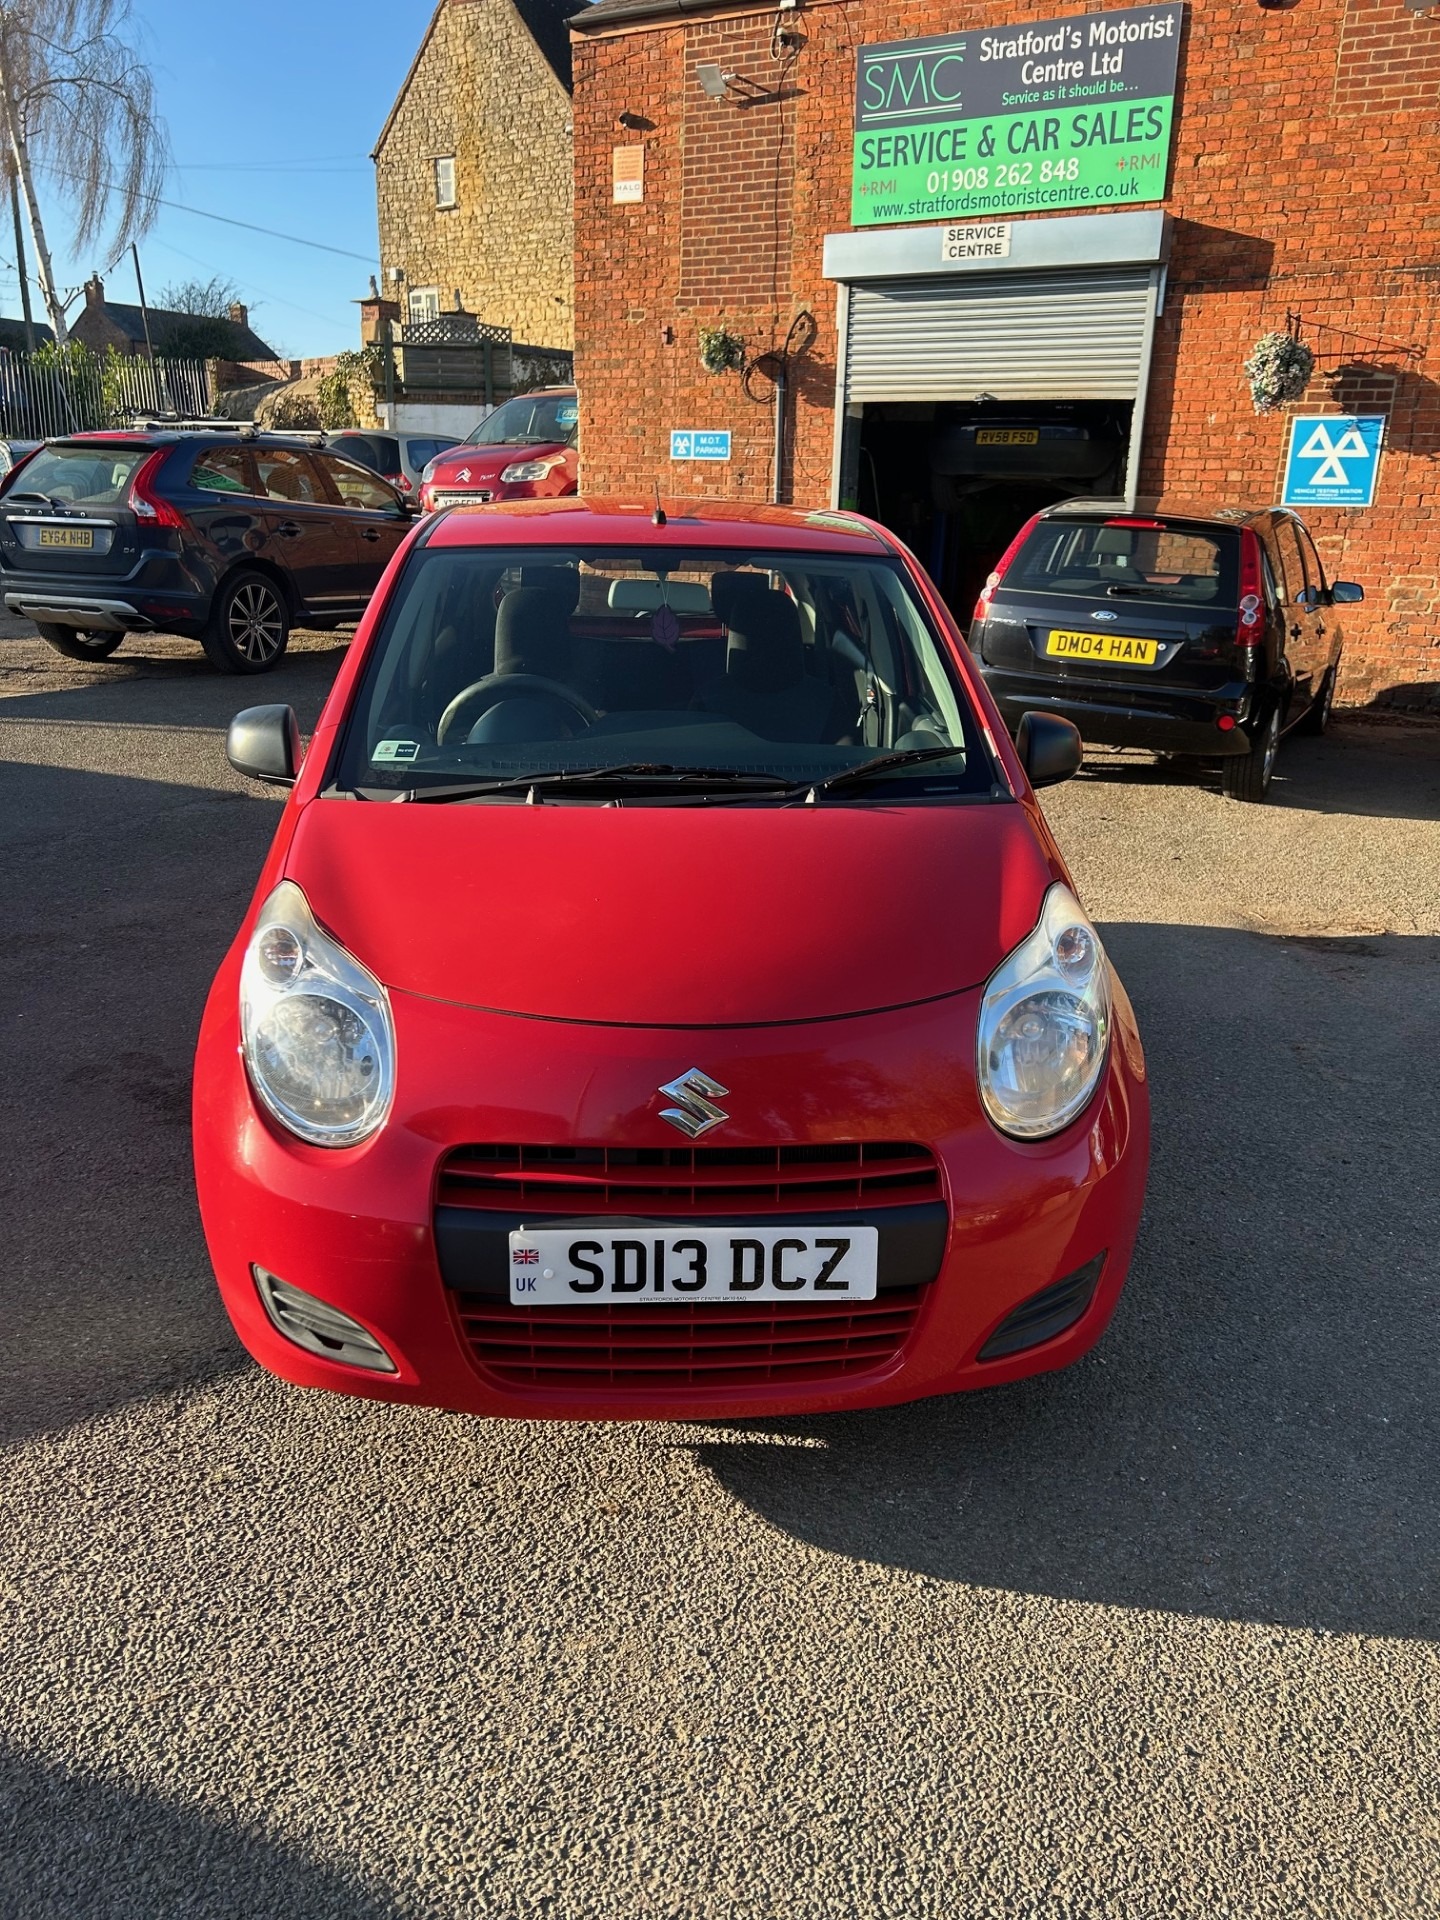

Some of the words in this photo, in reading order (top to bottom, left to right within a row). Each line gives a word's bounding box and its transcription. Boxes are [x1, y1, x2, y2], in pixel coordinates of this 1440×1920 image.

[980, 25, 1082, 61] Stratford's
[1088, 14, 1175, 47] Motorist
[1021, 58, 1084, 85] Centre
[1090, 48, 1124, 77] Ltd
[863, 55, 964, 110] SMC
[1001, 90, 1039, 106] Service
[1042, 89, 1055, 101] as
[1058, 85, 1066, 99] it
[1068, 79, 1107, 98] should
[860, 127, 968, 170] SERVICE
[977, 125, 996, 158] &
[1007, 117, 1061, 154] CAR
[1070, 105, 1163, 148] SALES
[1129, 152, 1161, 171] RMI
[927, 166, 989, 194] 01908
[994, 162, 1033, 188] 262
[1039, 157, 1080, 183] 848
[870, 179, 897, 196] RMI
[873, 177, 1139, 218] www.stratfordsmotoristcentre.co.uk
[948, 225, 1006, 241] SERVICE
[948, 243, 1003, 258] CENTRE
[980, 431, 1009, 443] RV58
[1011, 431, 1034, 443] FSD
[695, 446, 727, 455] PARKING
[24, 509, 87, 518] VOLVO
[41, 530, 67, 543] EY64
[69, 531, 91, 545] NHB
[1056, 635, 1104, 655] DM04
[1109, 640, 1148, 659] HAN
[568, 1239, 708, 1293] SD13
[729, 1238, 851, 1292] DCZ
[516, 1277, 537, 1292] UK
